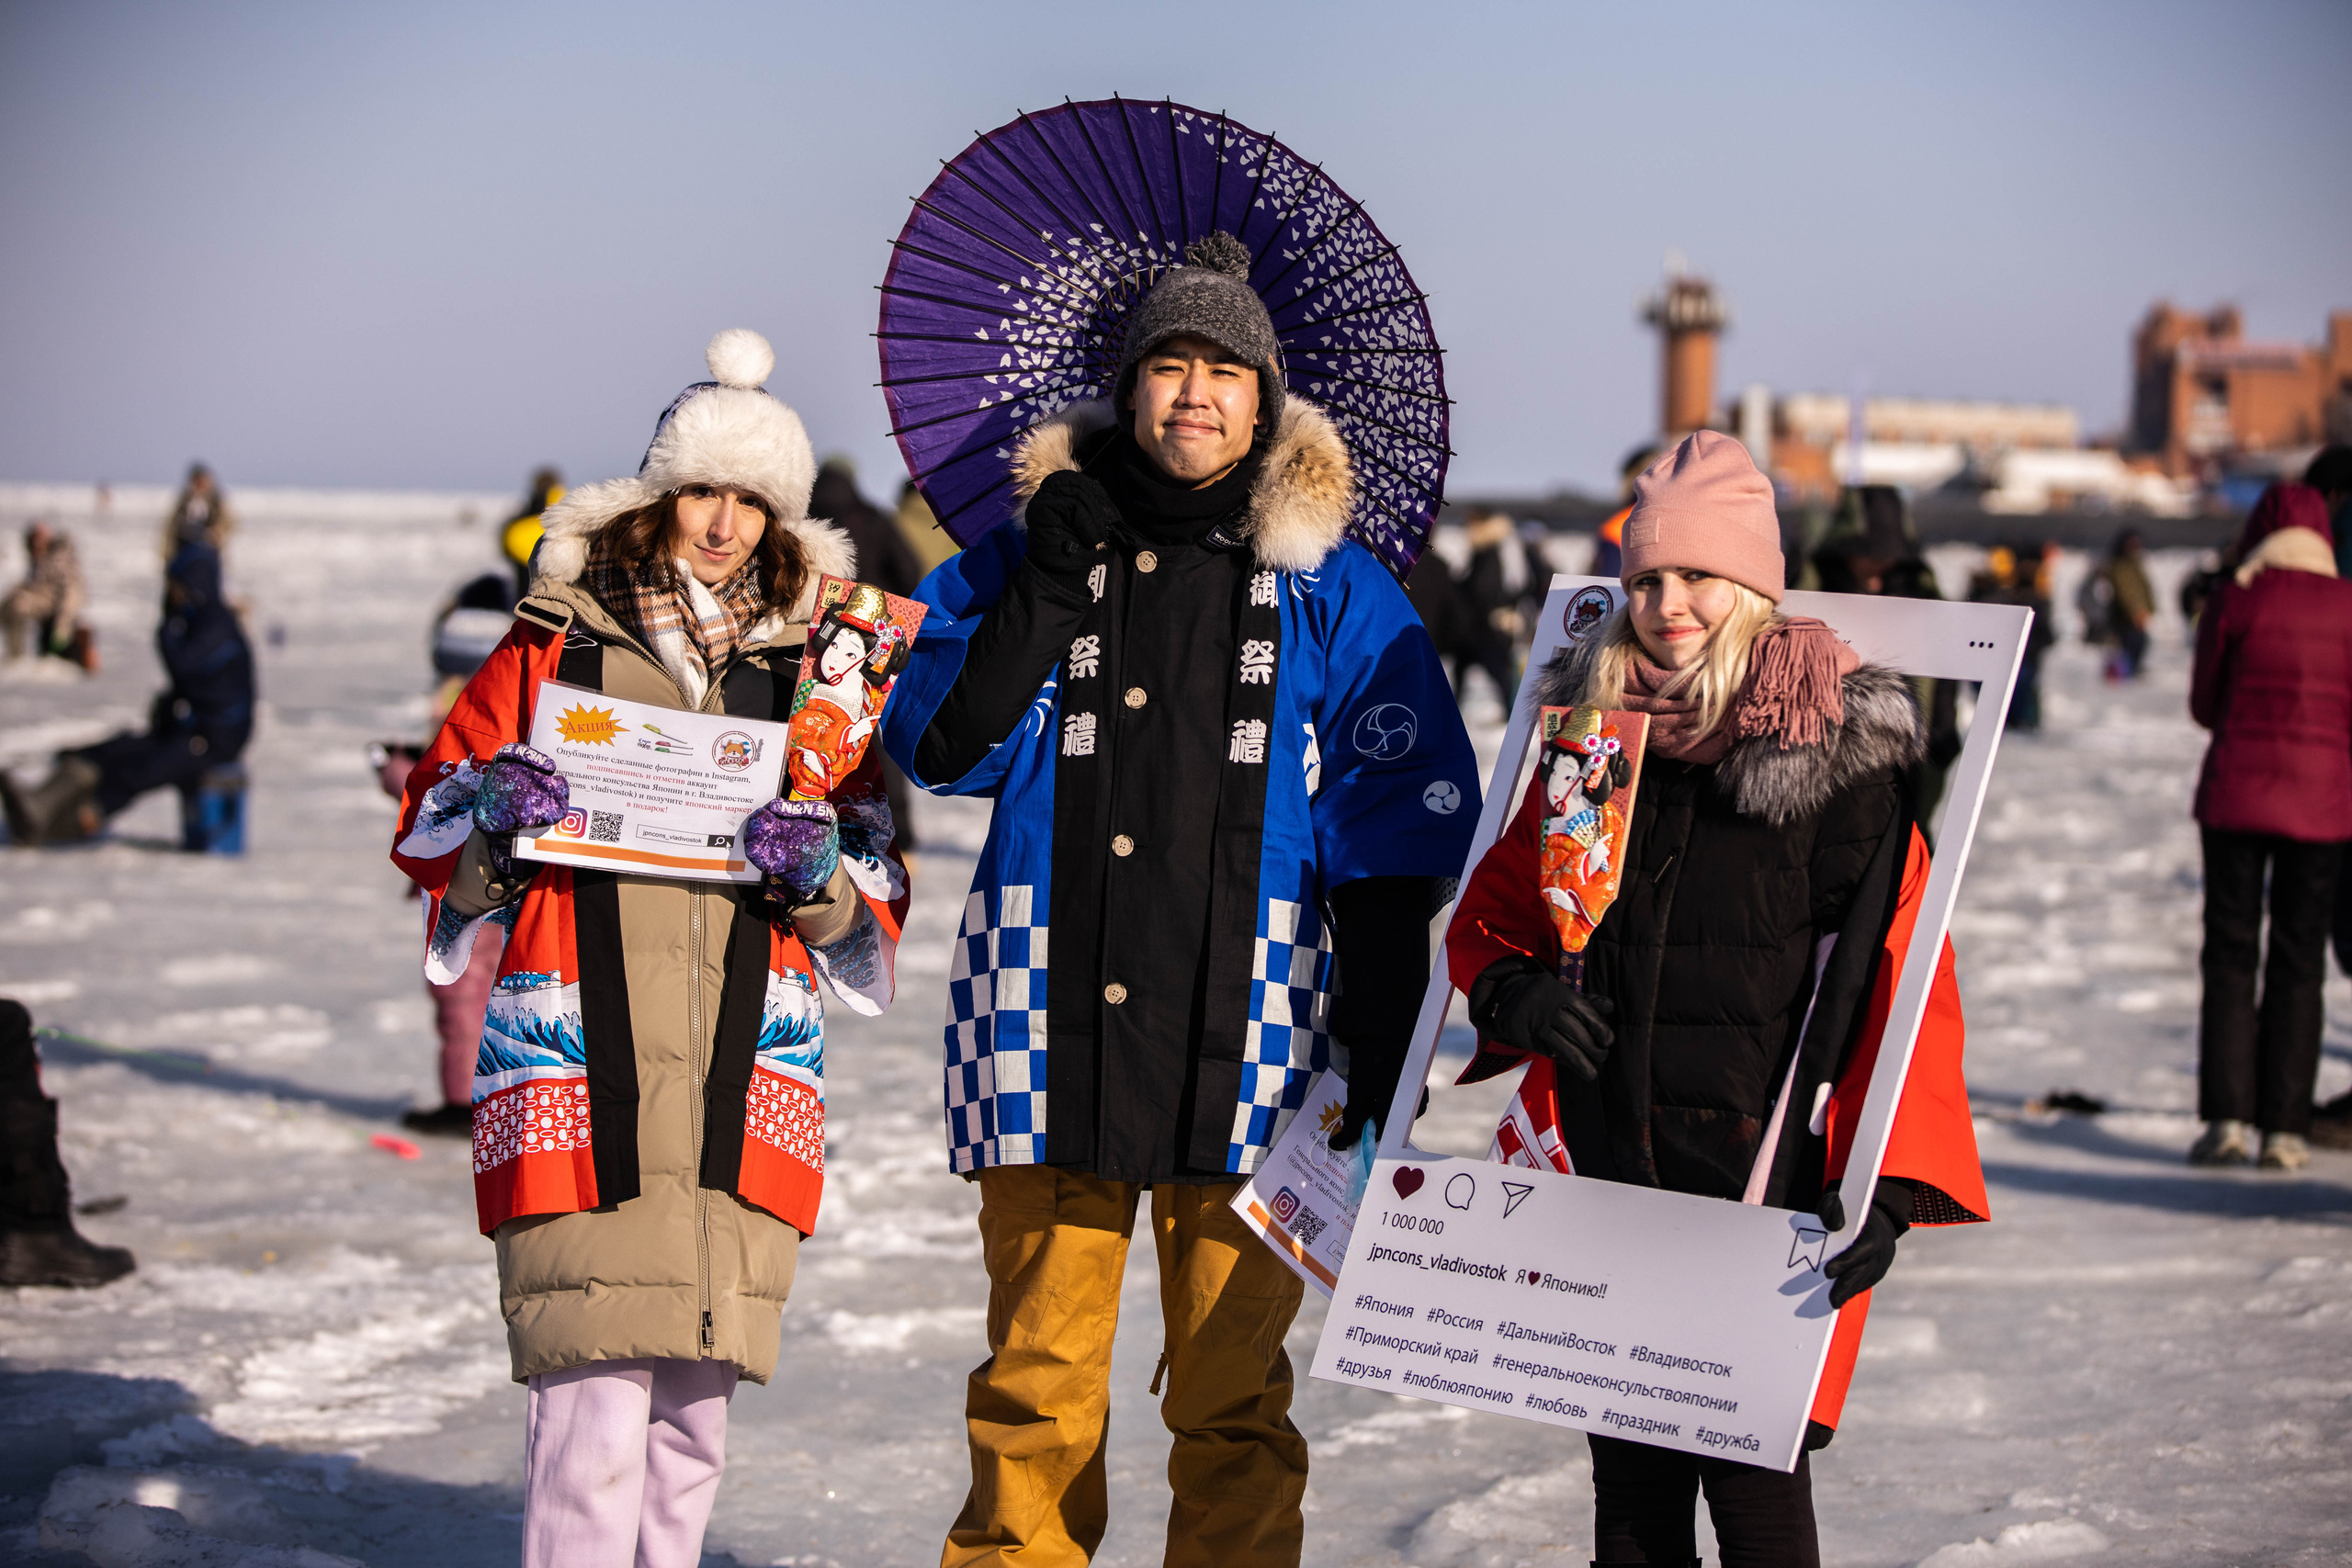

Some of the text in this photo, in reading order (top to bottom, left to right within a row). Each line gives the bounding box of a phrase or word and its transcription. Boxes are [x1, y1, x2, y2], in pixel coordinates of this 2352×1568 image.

[565, 721, 614, 734] Акция
[556, 747, 609, 762] Опубликуйте
[610, 757, 653, 770] сделанные
[654, 763, 703, 777] фотографии
[711, 772, 751, 784] Instagram,
[586, 763, 644, 778] подписавшись
[653, 776, 685, 784] отметив
[687, 780, 718, 790] аккаунт
[556, 770, 601, 782] нерального
[602, 777, 650, 790] консульства
[651, 784, 683, 795] Японии
[698, 791, 753, 804] Владивостоке
[569, 782, 638, 798] cons_vladivostok)
[646, 794, 684, 806] получите
[684, 800, 722, 811] японский
[724, 806, 752, 815] маркер
[633, 802, 668, 813] подарок!
[642, 829, 702, 843] jpncons_vladivostok
[1381, 1211, 1444, 1235] 1 000 000
[1367, 1243, 1508, 1281] jpncons_vladivostok
[1354, 1294, 1733, 1378] #Япония #Россия #ДальнийВосток #Владивосток
[1345, 1325, 1738, 1413] #Приморский край #генеральноеконсульствояпонии
[1336, 1357, 1760, 1452] #друзья #люблюяпонию #любовь #праздник #дружба
